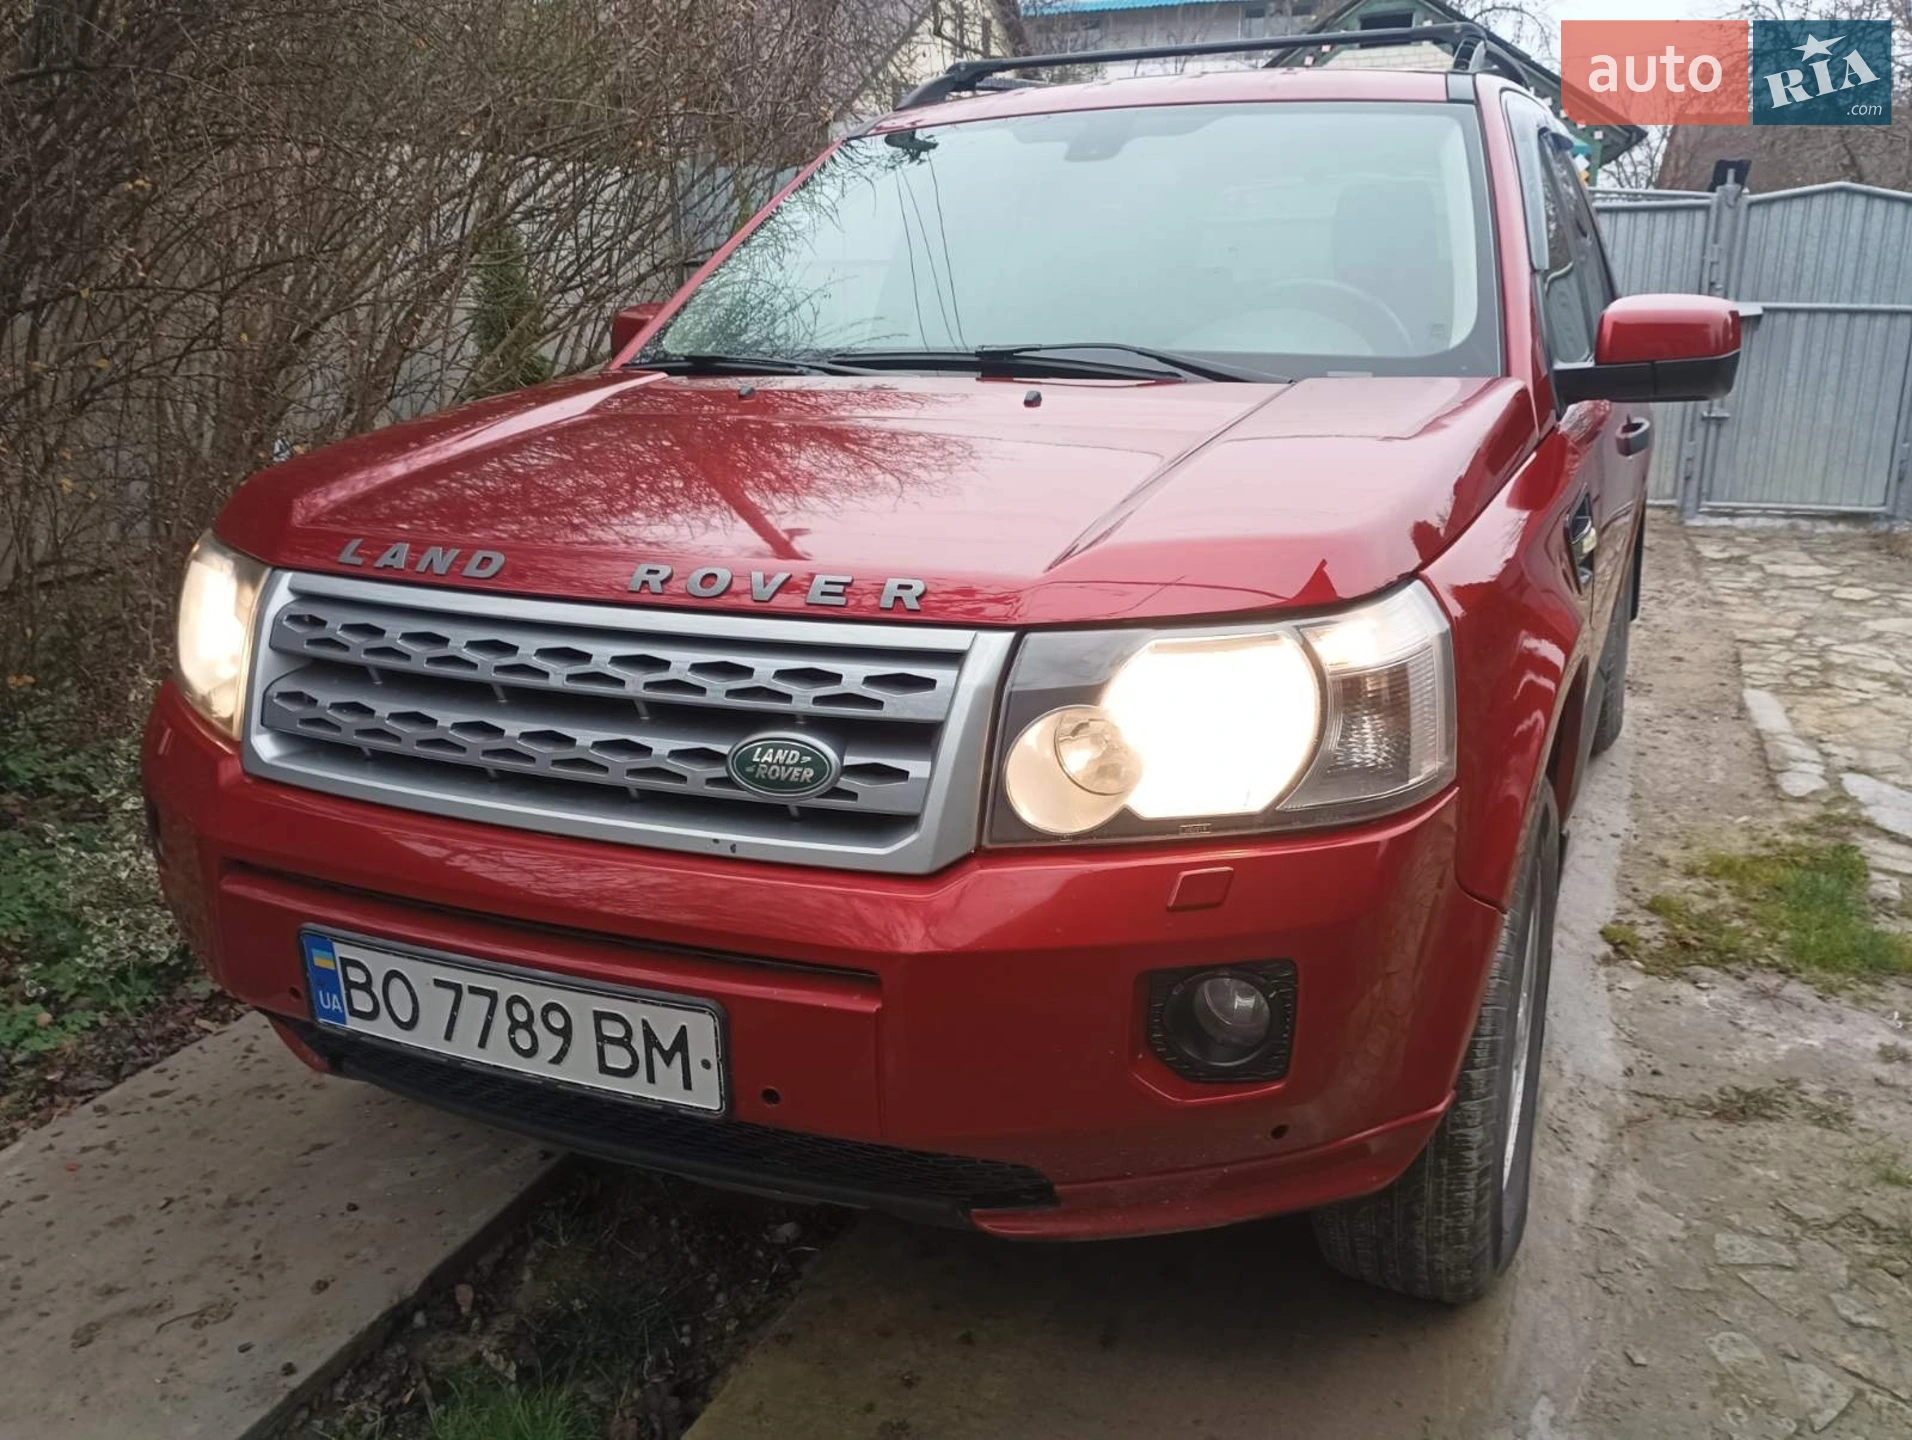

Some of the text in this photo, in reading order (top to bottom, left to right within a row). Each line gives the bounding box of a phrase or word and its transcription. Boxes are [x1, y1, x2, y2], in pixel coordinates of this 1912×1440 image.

[337, 538, 927, 610] LAND ROVER
[752, 747, 800, 765] LAND
[755, 763, 814, 782] ROVER
[319, 990, 343, 1013] UA
[339, 955, 692, 1091] BO 7789 BM
